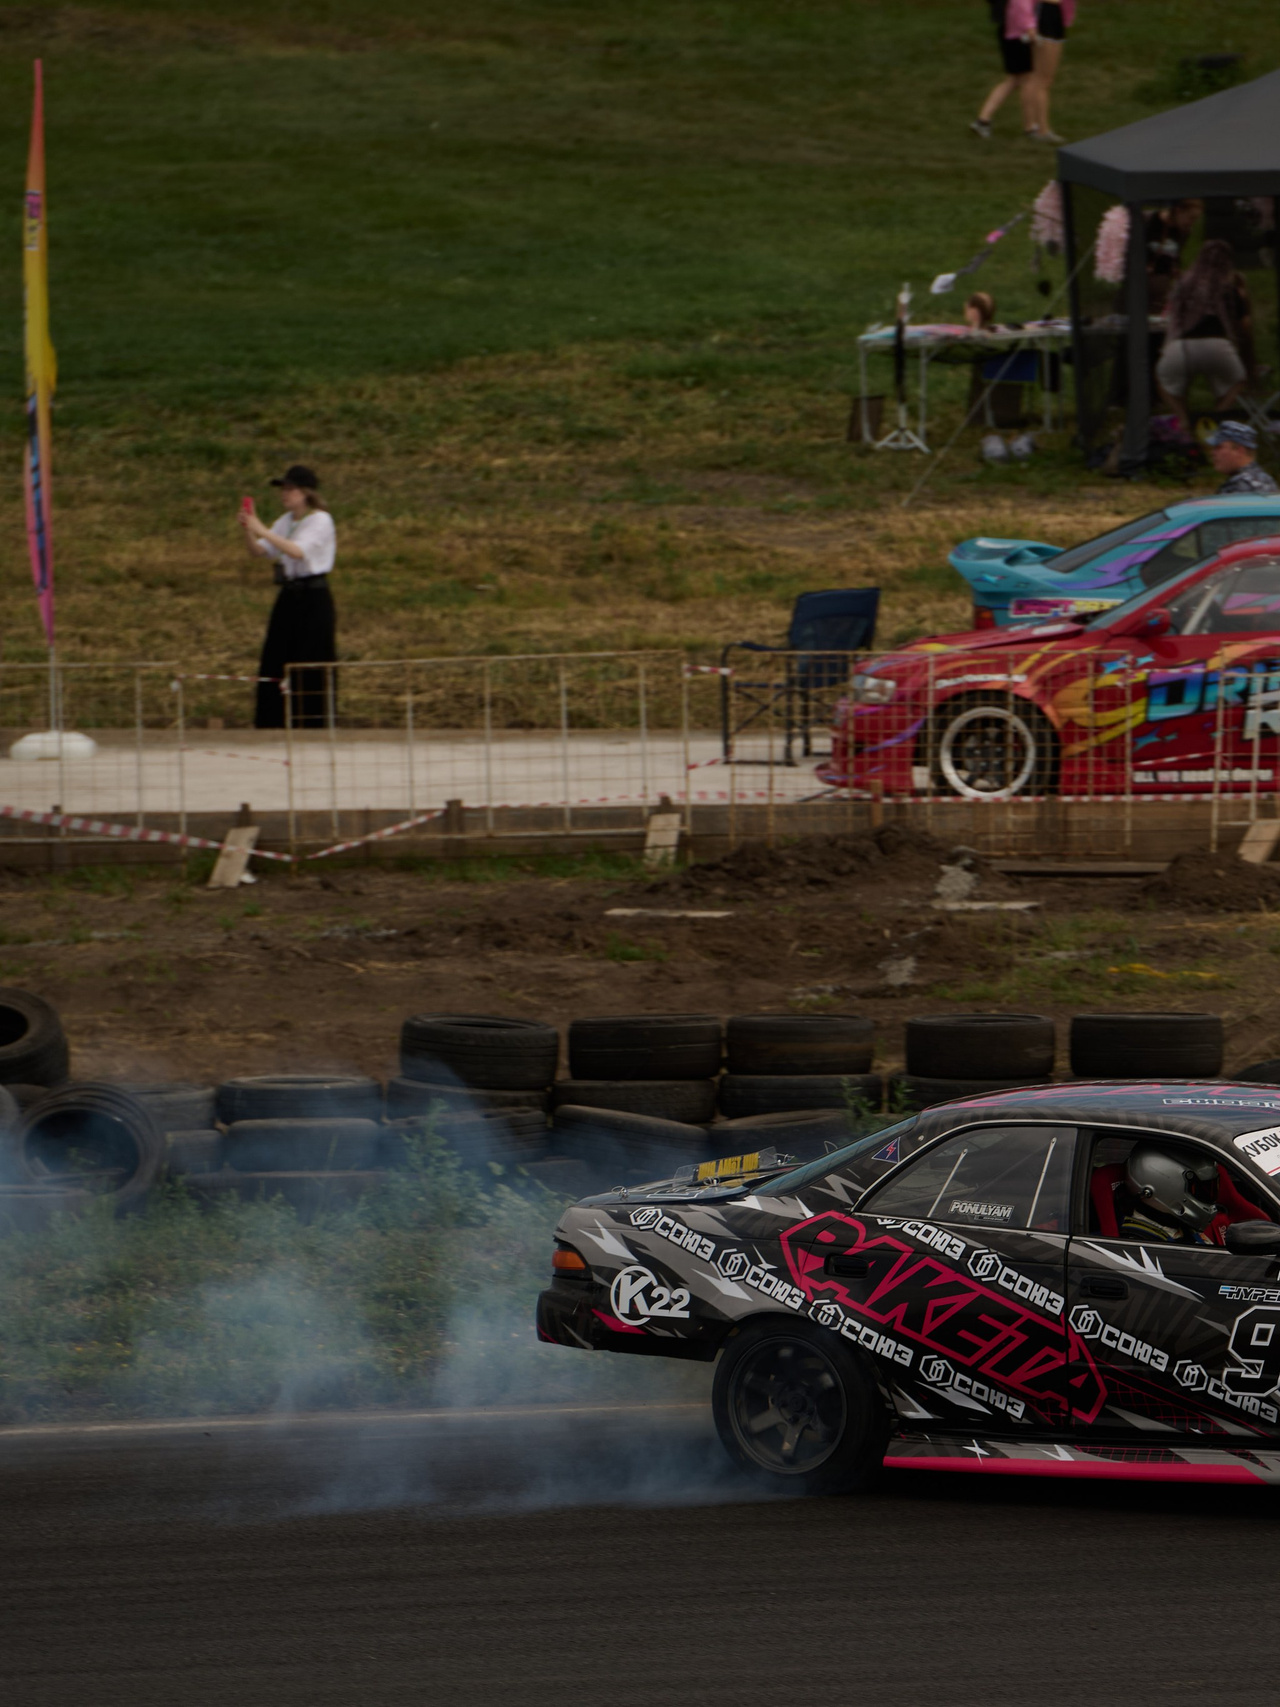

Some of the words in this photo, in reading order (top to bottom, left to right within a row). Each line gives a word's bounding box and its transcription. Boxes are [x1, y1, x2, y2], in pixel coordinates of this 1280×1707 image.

[950, 1201, 1013, 1218] PONULYAM
[653, 1216, 715, 1262] СОЮЗ
[902, 1219, 967, 1261] СОЮЗ
[616, 1271, 691, 1320] K22
[745, 1267, 806, 1312] СОЮЗ
[997, 1267, 1066, 1317] СОЮЗ
[840, 1315, 914, 1368] СОЮЗ
[1101, 1322, 1170, 1373] СОЮЗ
[953, 1373, 1026, 1420] СОЮЗ
